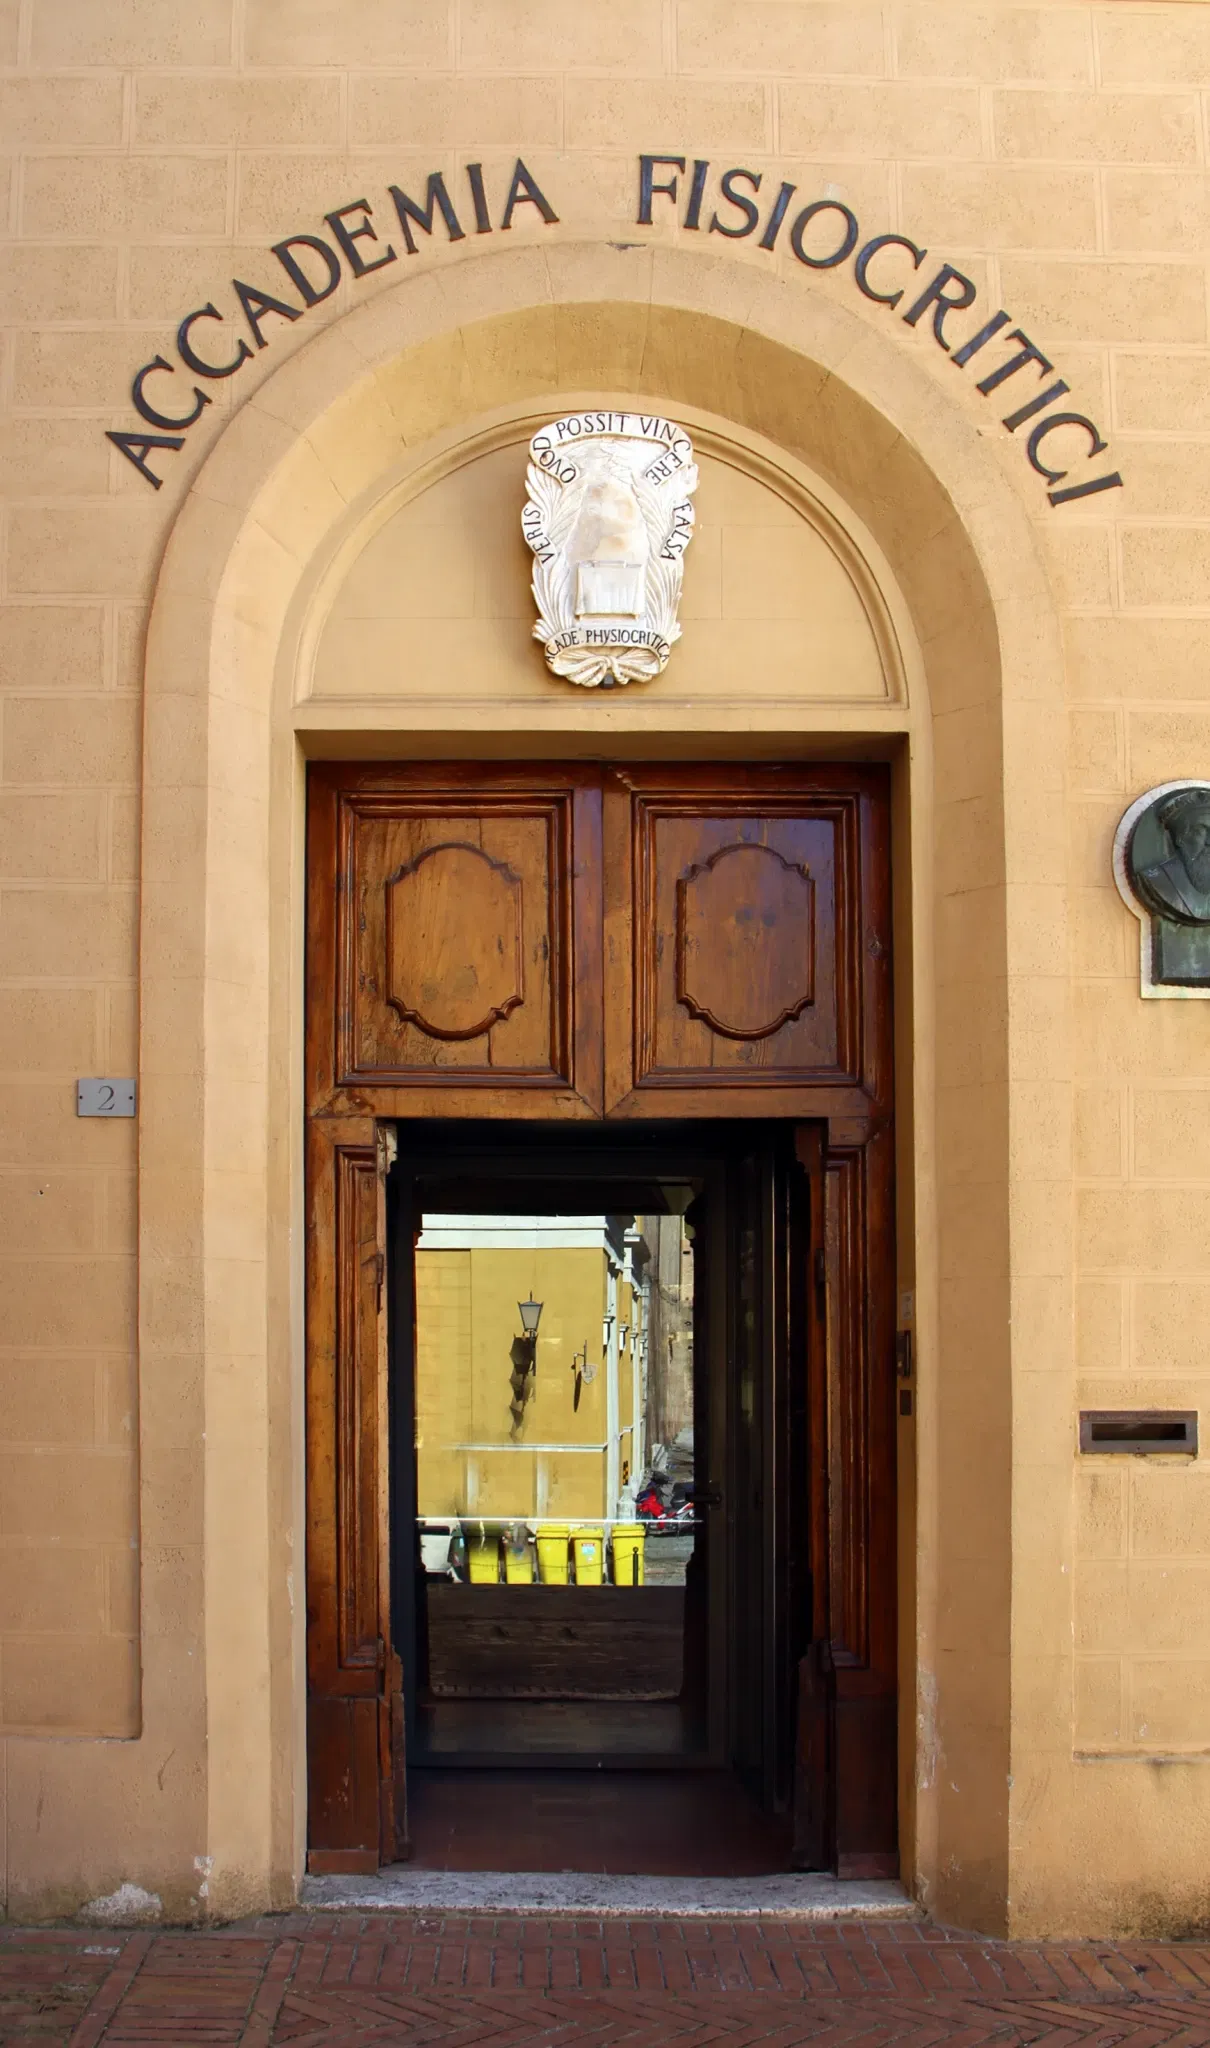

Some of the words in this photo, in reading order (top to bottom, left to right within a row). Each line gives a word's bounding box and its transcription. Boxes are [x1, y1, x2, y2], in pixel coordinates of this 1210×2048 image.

[105, 157, 560, 490] ACCADEMIA
[637, 154, 1123, 508] FISIOCRITICI
[555, 413, 630, 440] POSSIT
[523, 507, 555, 564] VERIS
[660, 502, 692, 560] FALSA
[97, 1085, 115, 1111] 2
